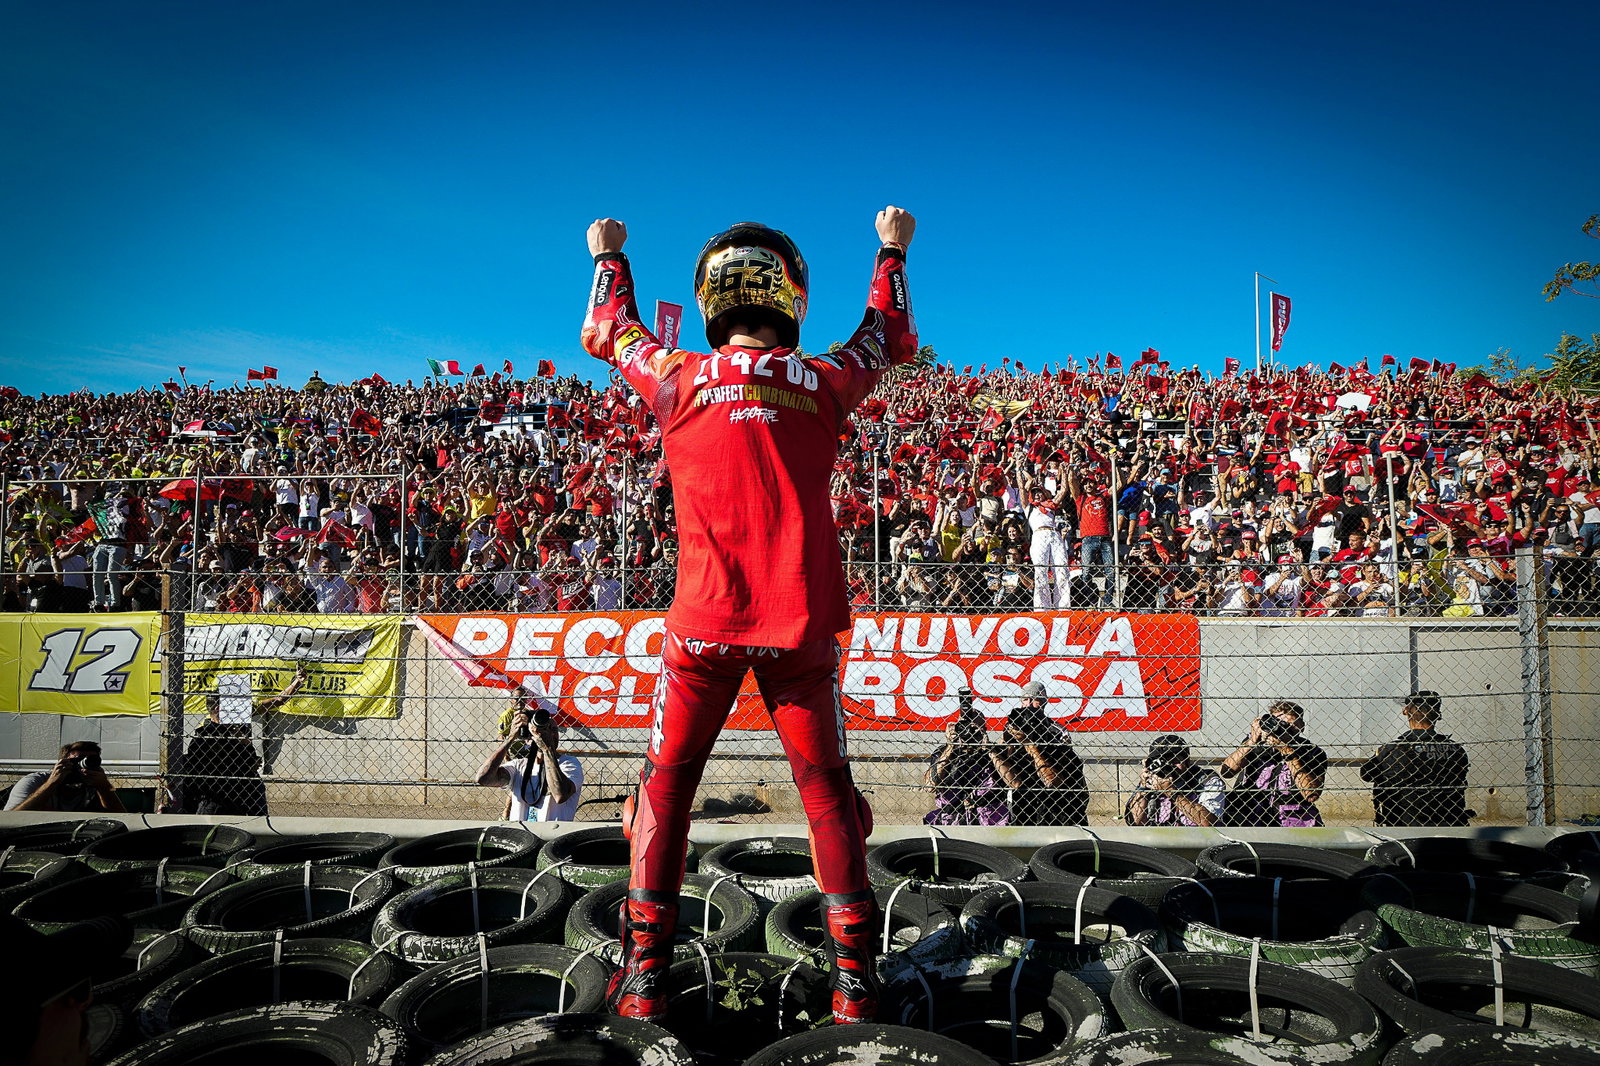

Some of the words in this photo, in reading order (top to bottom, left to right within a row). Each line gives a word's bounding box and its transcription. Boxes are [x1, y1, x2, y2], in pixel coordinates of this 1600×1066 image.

[597, 270, 612, 304] Lenovo
[719, 259, 774, 295] 63
[893, 273, 905, 310] Lenovo
[664, 315, 675, 349] DUCA
[27, 627, 144, 694] 12
[152, 623, 352, 663] AVERICK
[452, 617, 665, 674] PECC
[848, 616, 1137, 659] NUVOLA
[250, 672, 280, 688] FAN
[841, 660, 1149, 718] ROSSA
